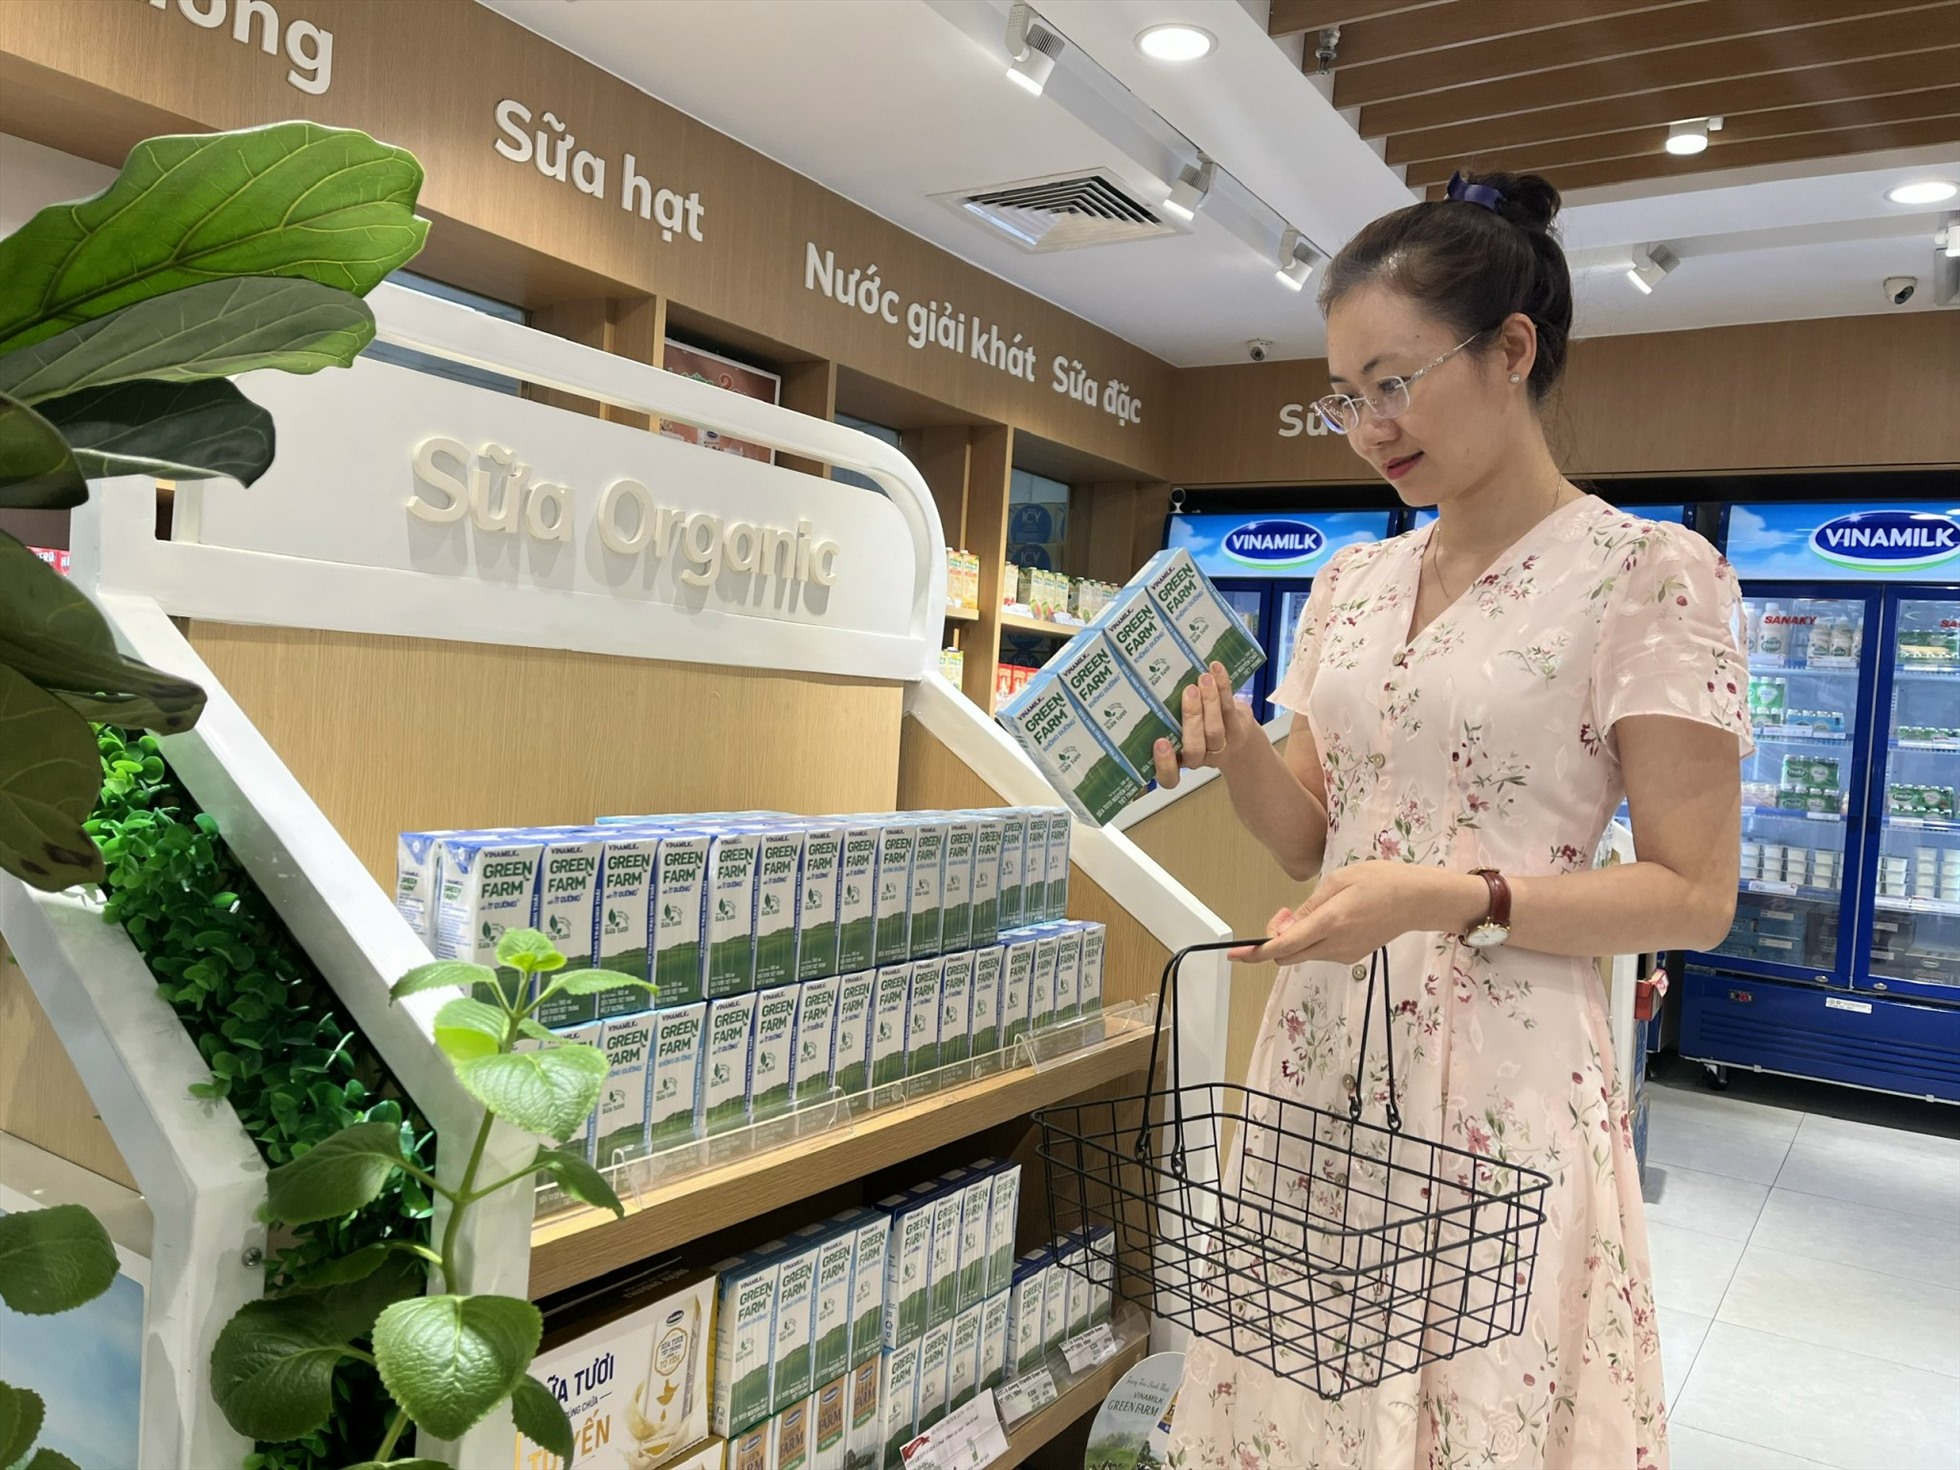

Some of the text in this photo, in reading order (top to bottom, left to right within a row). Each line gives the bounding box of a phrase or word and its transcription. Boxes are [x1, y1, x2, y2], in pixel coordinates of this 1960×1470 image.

[494, 98, 705, 243] Sữa hạt
[804, 242, 1036, 383] Nước giải khát
[1051, 355, 1142, 426] Sữa đặc
[406, 435, 839, 587] Sữa Organic
[1022, 511, 1041, 523] ICY
[1232, 533, 1317, 551] VINAMILK
[1826, 527, 1955, 548] VINAMILK
[1020, 551, 1041, 564] ICY
[1151, 567, 1174, 591] VINAMILK
[1158, 563, 1194, 602] GREEN
[1166, 579, 1197, 615] FARM
[1109, 609, 1133, 632] VINAMILK
[1116, 604, 1153, 644] GREEN
[1765, 615, 1817, 626] SANAKY
[1125, 621, 1157, 657] FARM
[1063, 654, 1088, 677] VINAMILK
[1070, 648, 1109, 689] GREEN
[1078, 665, 1113, 701] FARM
[1017, 698, 1044, 721] VINAMILK
[1024, 691, 1065, 732] GREEN
[1033, 708, 1068, 745] FARM
[847, 839, 875, 853] GREEN
[885, 837, 912, 850] GREEN
[918, 835, 942, 848] GREEN
[950, 833, 973, 844] GREEN
[719, 847, 753, 863] GREEN
[765, 845, 797, 859] GREEN
[808, 842, 838, 856] GREEN
[883, 852, 906, 864] FARM
[916, 848, 937, 861] FARM
[949, 845, 968, 858] FARM
[549, 856, 595, 874] GREEN
[608, 853, 651, 870] GREEN
[664, 851, 703, 866] GREEN
[807, 857, 832, 871] FARM
[846, 854, 870, 868] FARM
[483, 860, 533, 879] GREEN
[663, 868, 696, 884] FARM
[717, 864, 747, 880] FARM
[764, 861, 791, 875] FARM
[547, 876, 586, 893] FARM
[606, 871, 642, 888] FARM
[481, 880, 523, 898] FARM
[978, 957, 1000, 970] GREEN
[1011, 951, 1031, 965] GREEN
[915, 968, 940, 984] GREEN
[946, 961, 970, 977] GREEN
[977, 970, 995, 984] FARM
[1010, 965, 1027, 978] FARM
[844, 983, 870, 1000] GREEN
[881, 975, 907, 991] GREEN
[914, 983, 935, 999] FARM
[945, 976, 966, 990] FARM
[805, 990, 834, 1008] GREEN
[842, 999, 864, 1014] FARM
[879, 991, 902, 1006] FARM
[714, 1007, 750, 1028] GREEN
[762, 999, 794, 1018] GREEN
[802, 1006, 828, 1023] FARM
[660, 1019, 698, 1040] GREEN
[760, 1015, 787, 1034] FARM
[607, 1029, 649, 1051] GREEN
[713, 1025, 742, 1045] FARM
[659, 1036, 691, 1057] FARM
[606, 1047, 640, 1067] FARM
[905, 1214, 931, 1235] GREEN
[859, 1229, 885, 1251] GREEN
[904, 1231, 926, 1249] FARM
[822, 1244, 850, 1268] GREEN
[858, 1246, 880, 1266] FARM
[782, 1262, 812, 1287] GREEN
[821, 1263, 845, 1283] FARM
[740, 1280, 773, 1306] GREEN
[781, 1280, 807, 1303] FARM
[738, 1298, 767, 1322] FARM
[924, 1333, 948, 1355] GREEN
[891, 1350, 916, 1374] GREEN
[923, 1351, 944, 1369] FARM
[574, 1352, 615, 1396] TƯƠI
[890, 1368, 911, 1388] FARM
[1133, 1391, 1166, 1405] VINAMILK
[1107, 1399, 1160, 1417] GREEN FARM
[818, 1407, 841, 1433] FARM
